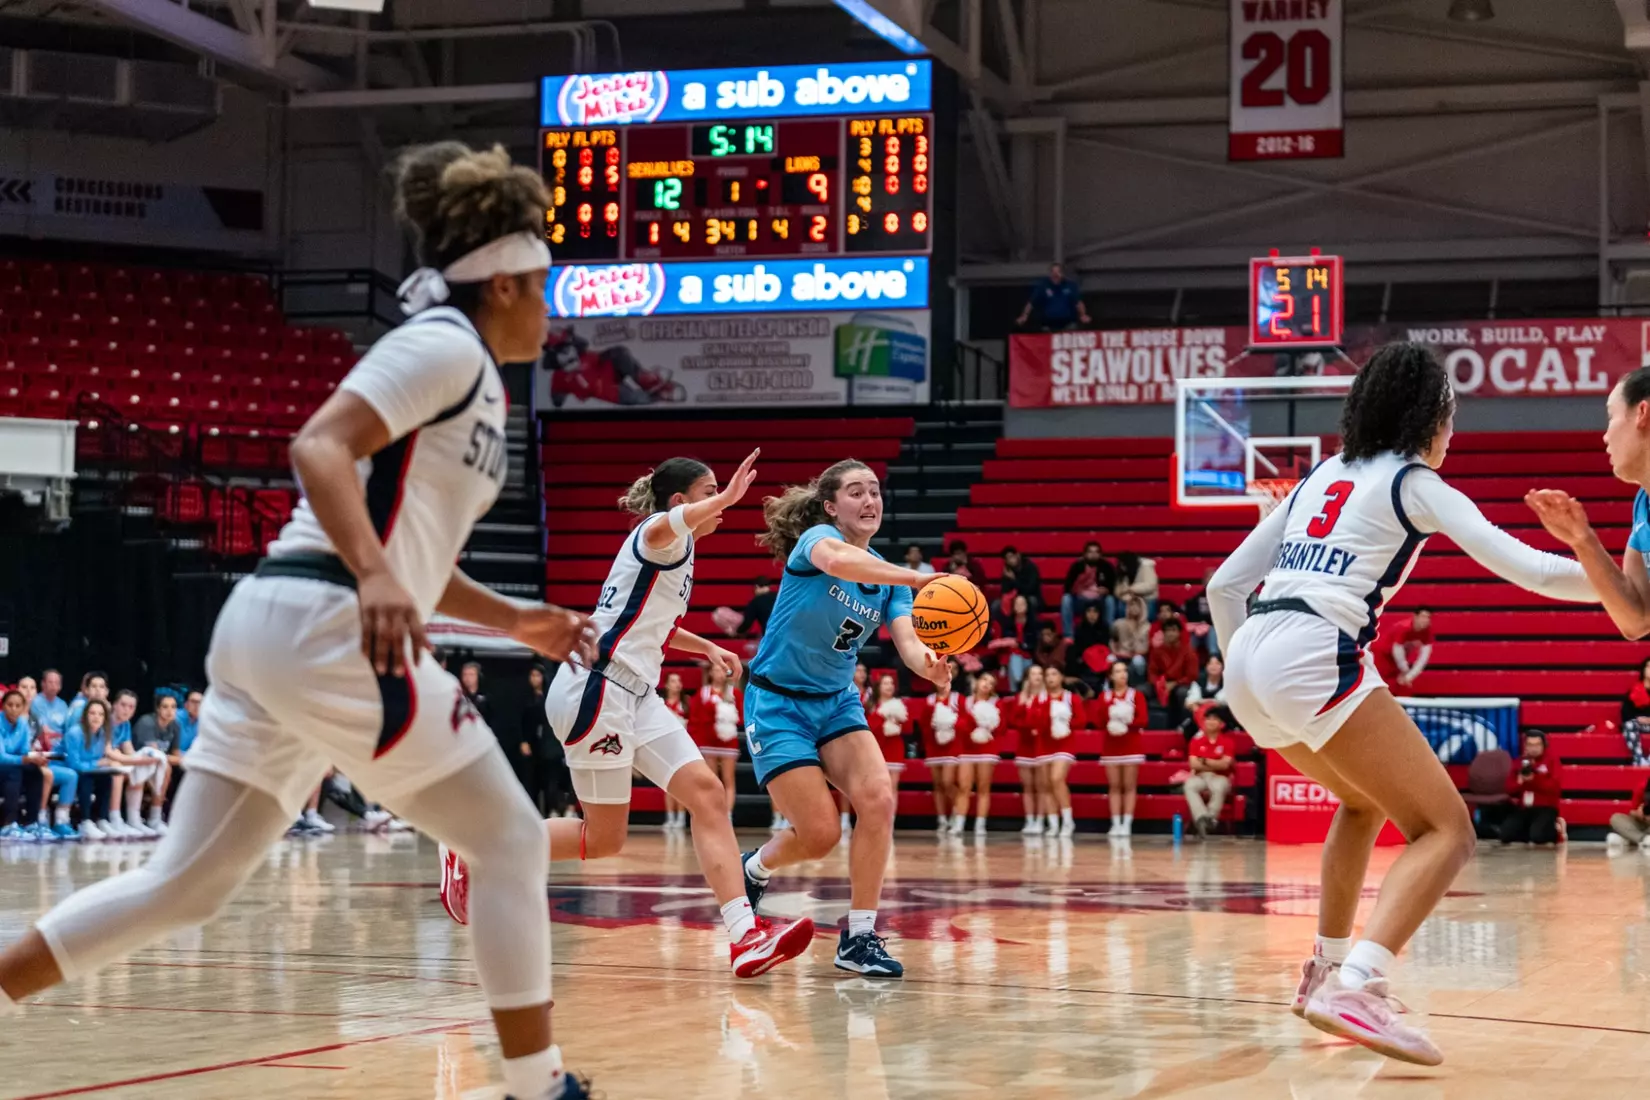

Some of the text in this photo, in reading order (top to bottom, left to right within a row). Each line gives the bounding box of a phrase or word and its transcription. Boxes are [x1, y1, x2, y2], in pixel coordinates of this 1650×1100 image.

[1241, 29, 1331, 107] 20
[575, 71, 651, 100] Jersey
[682, 67, 911, 110] a sub above
[590, 130, 616, 146] PTS
[897, 118, 924, 134] PTS
[709, 125, 773, 156] 5:14
[1256, 135, 1315, 154] 2012-16
[55, 176, 164, 200] CONCESSIONS
[654, 178, 682, 209] 12
[731, 181, 740, 202] 1
[807, 173, 828, 203] 9
[55, 195, 147, 218] RESTROOMS
[649, 221, 659, 244] 1
[673, 221, 690, 243] 4
[705, 218, 735, 244] 34
[772, 219, 789, 239] 4
[809, 215, 827, 242] 2
[572, 263, 645, 291] Jersey
[678, 263, 907, 304] a sub above
[1276, 268, 1328, 291] 5 14
[640, 319, 707, 341] OFFICIAL
[755, 317, 830, 337] SPONSOR
[1052, 328, 1226, 350] BRING THE HOUSE DOWN
[1408, 326, 1607, 345] WORK, BUILD, PLAY
[1052, 346, 1227, 385] SEAWOLVES
[1445, 347, 1609, 394] OCAL
[1052, 385, 1091, 403] WE'LL
[1096, 385, 1138, 401] BUILD
[1143, 383, 1157, 400] IT
[1306, 480, 1355, 539] 3
[1274, 541, 1358, 577] RANTLEY
[745, 723, 762, 755] C
